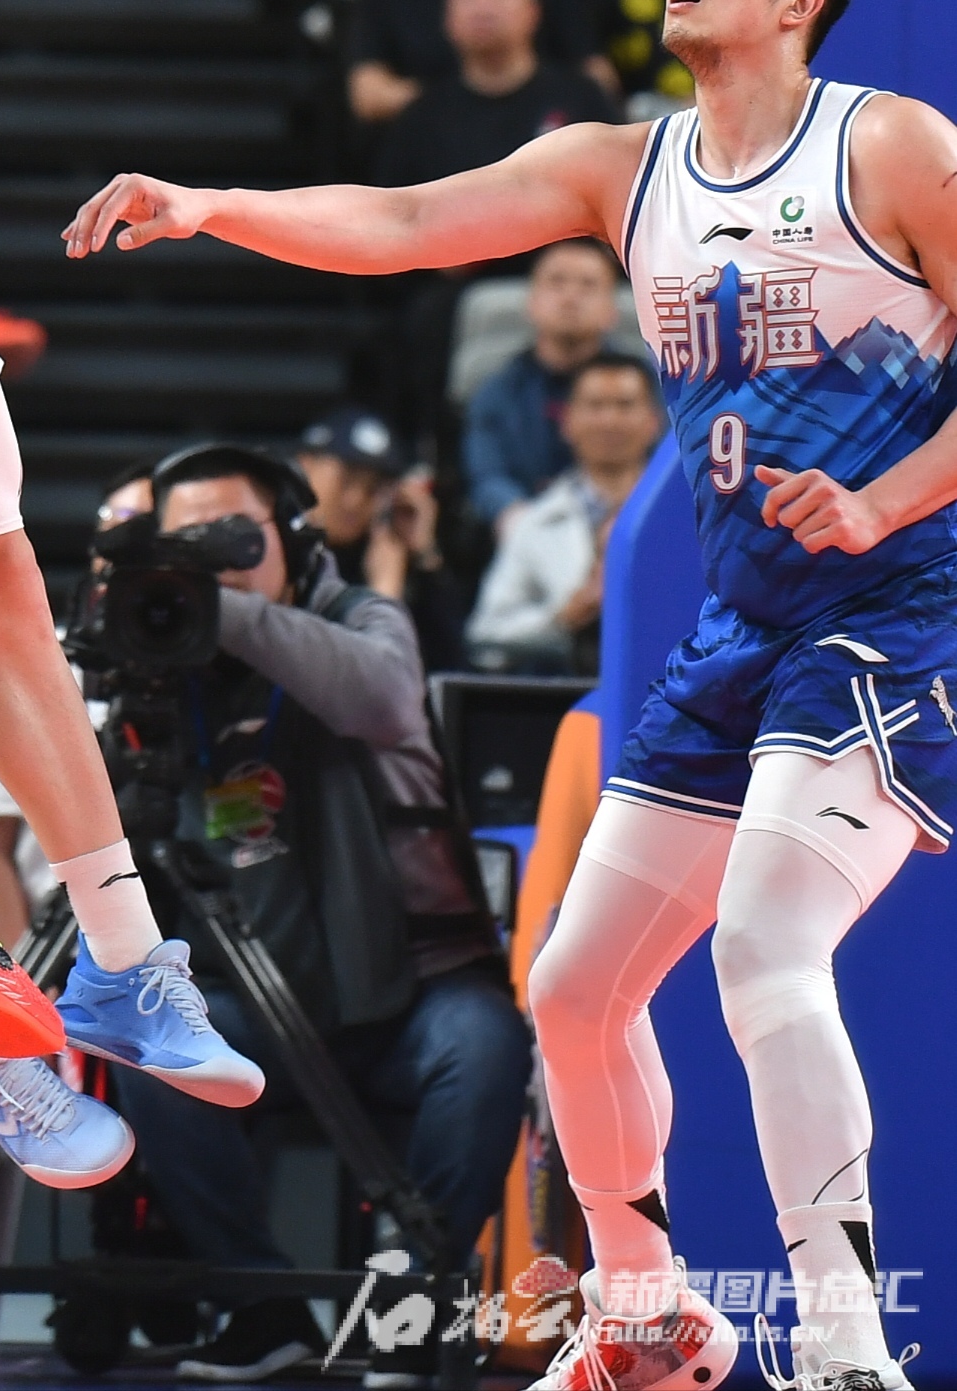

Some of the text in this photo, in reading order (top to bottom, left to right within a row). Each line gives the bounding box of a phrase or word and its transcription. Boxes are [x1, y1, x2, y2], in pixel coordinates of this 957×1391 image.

[772, 227, 813, 238] 中国人寿
[651, 264, 824, 383] 新疆
[709, 412, 746, 495] 9
